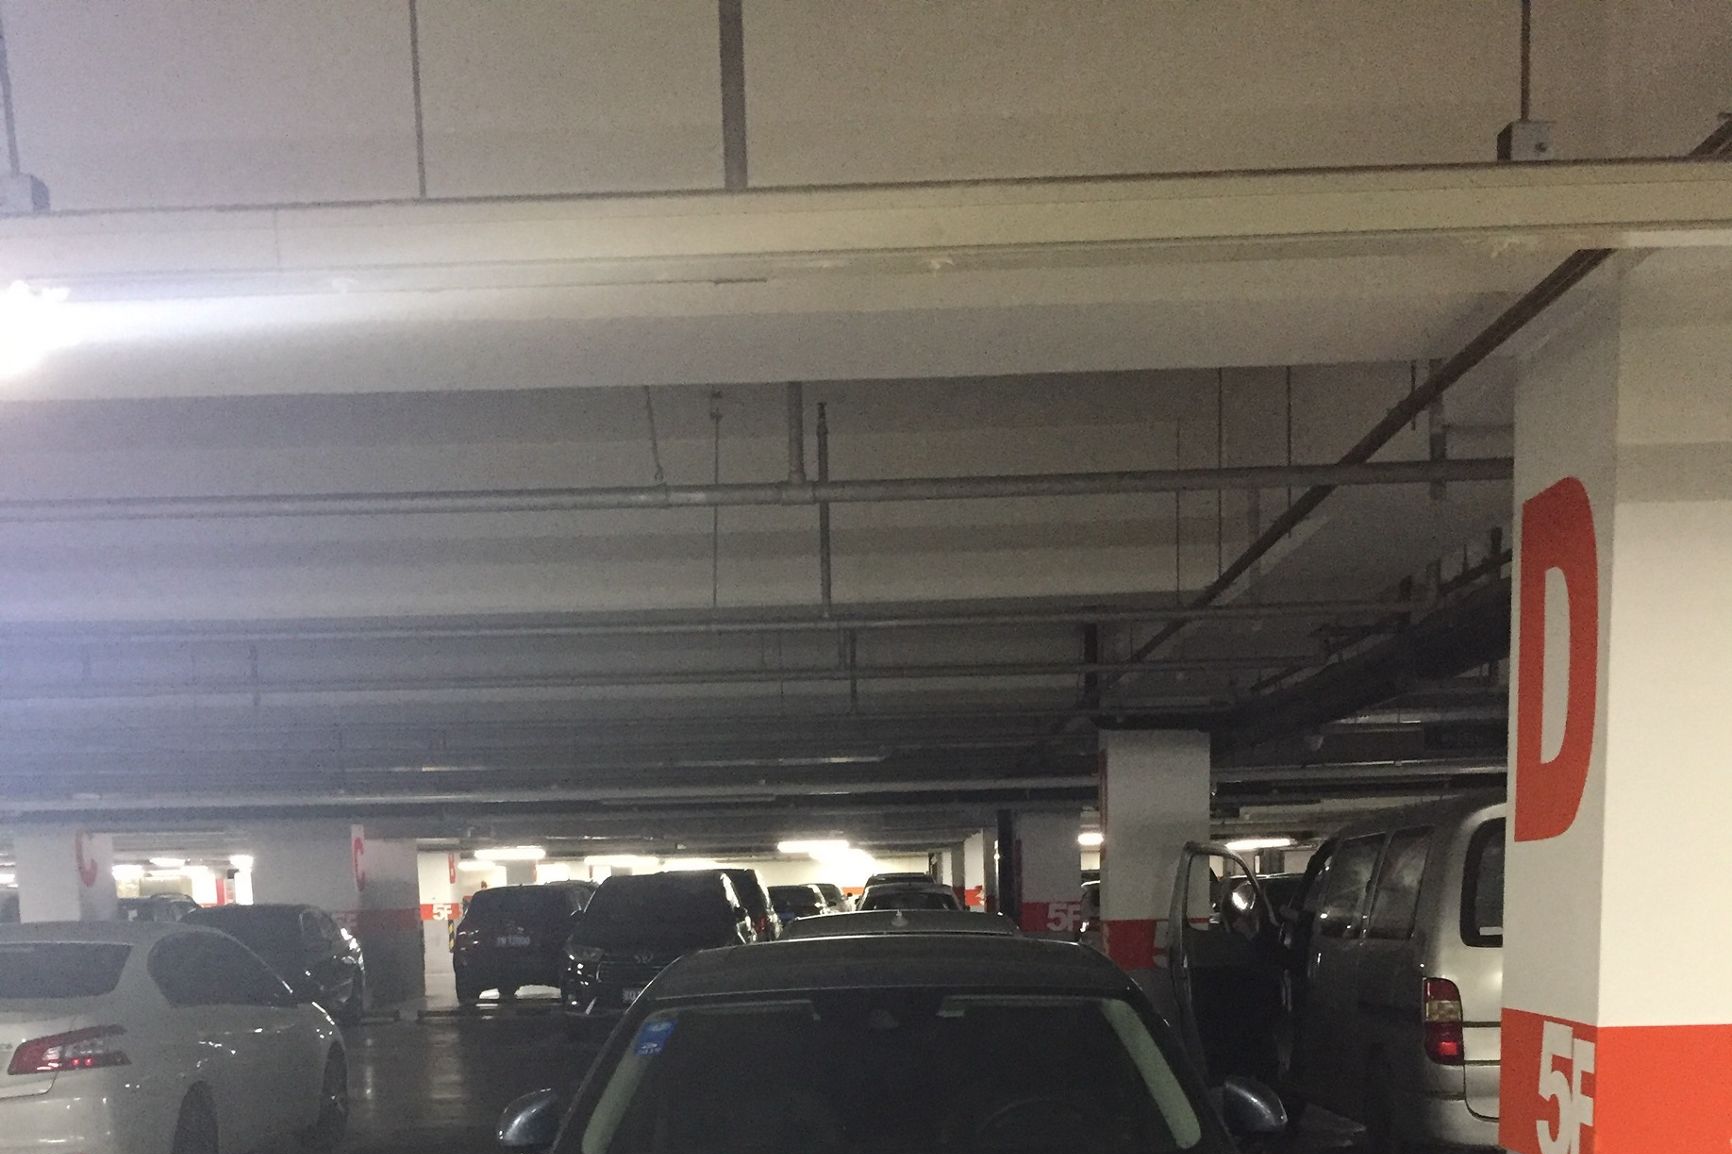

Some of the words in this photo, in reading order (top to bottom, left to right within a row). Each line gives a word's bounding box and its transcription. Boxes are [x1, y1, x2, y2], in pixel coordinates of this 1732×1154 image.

[1514, 476, 1598, 842] D
[353, 837, 366, 891] C
[432, 905, 453, 920] 5F
[1047, 904, 1081, 932] 5F
